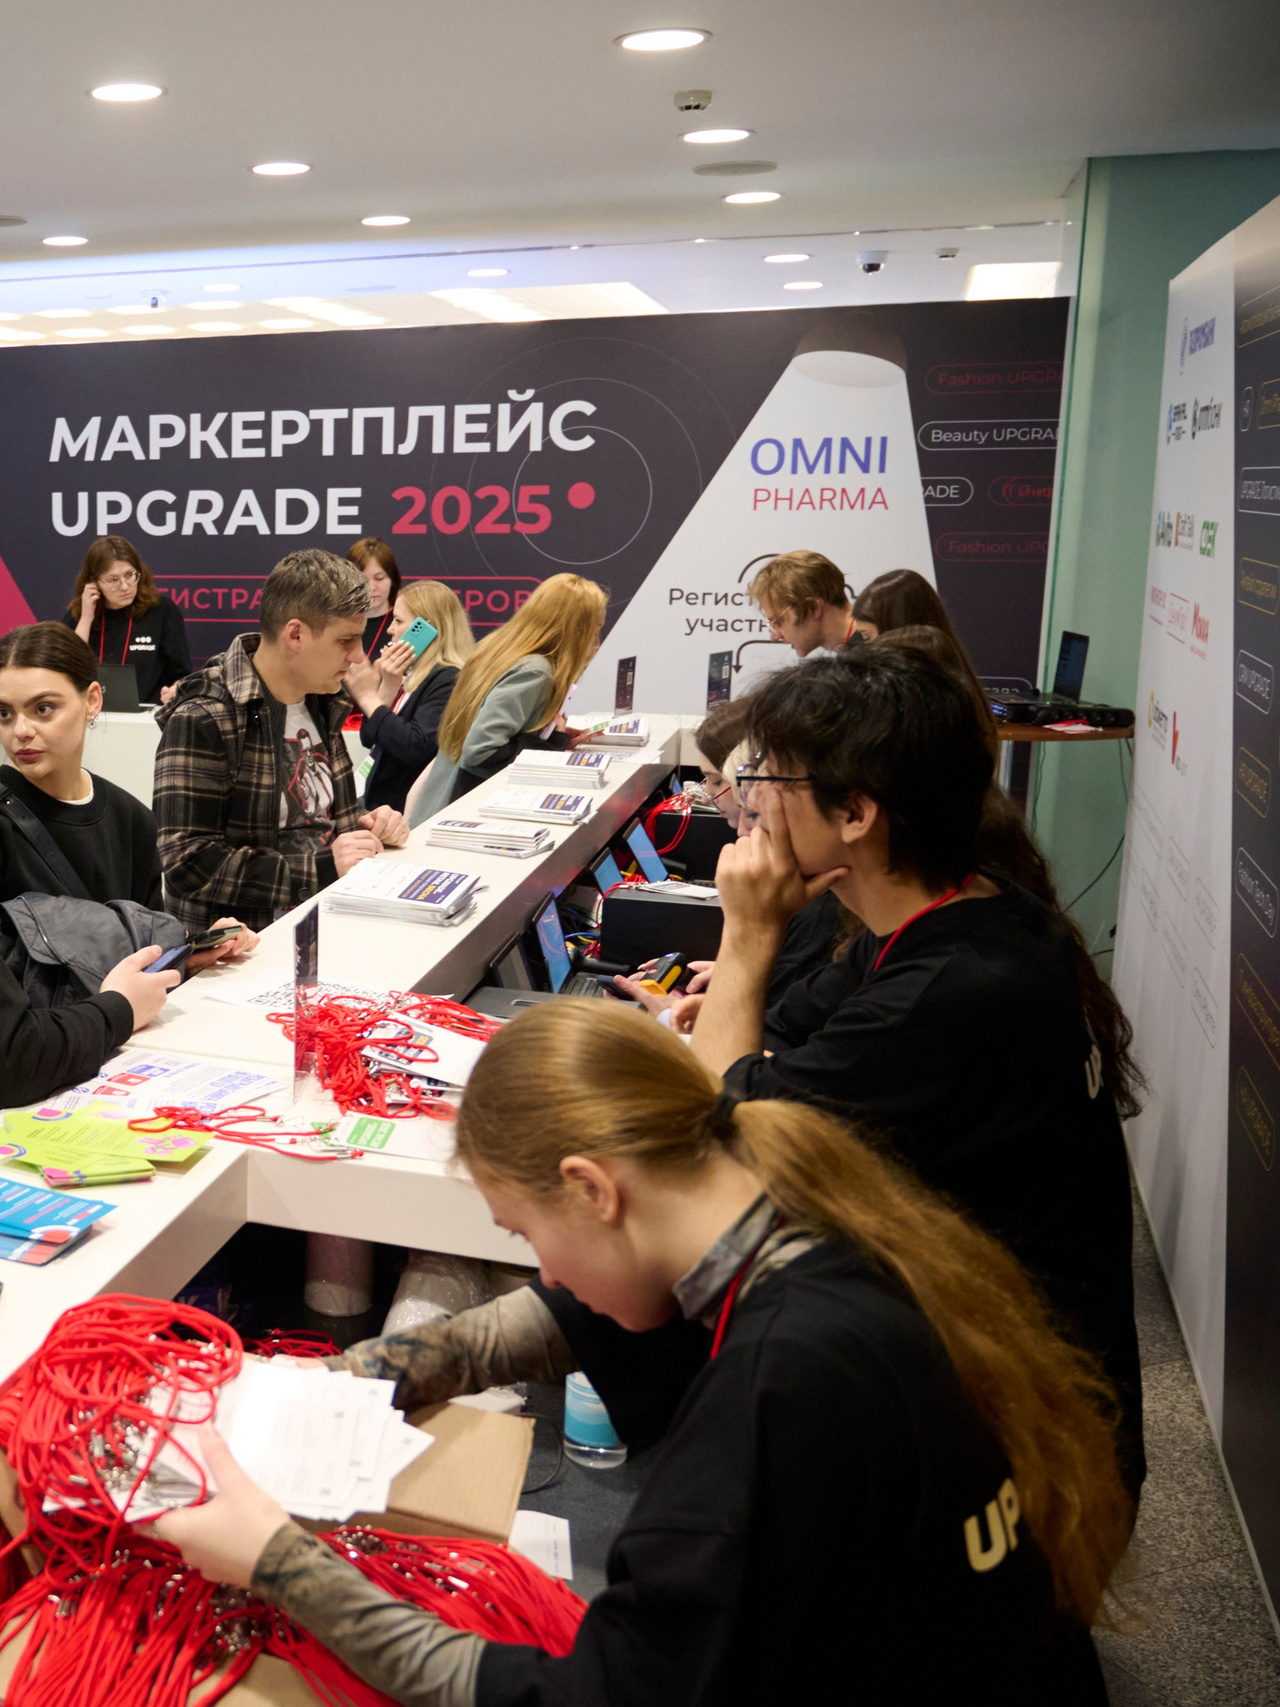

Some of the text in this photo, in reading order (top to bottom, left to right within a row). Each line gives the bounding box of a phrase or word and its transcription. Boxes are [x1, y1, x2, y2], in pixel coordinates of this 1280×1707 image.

[49, 389, 597, 463] МАРКЕРТПЛЕЙС
[930, 429, 989, 445] Beauty
[750, 436, 889, 476] OMNI
[752, 486, 889, 512] PHARMA
[923, 484, 960, 499] ADE
[51, 484, 552, 537] UPGRADE 2025
